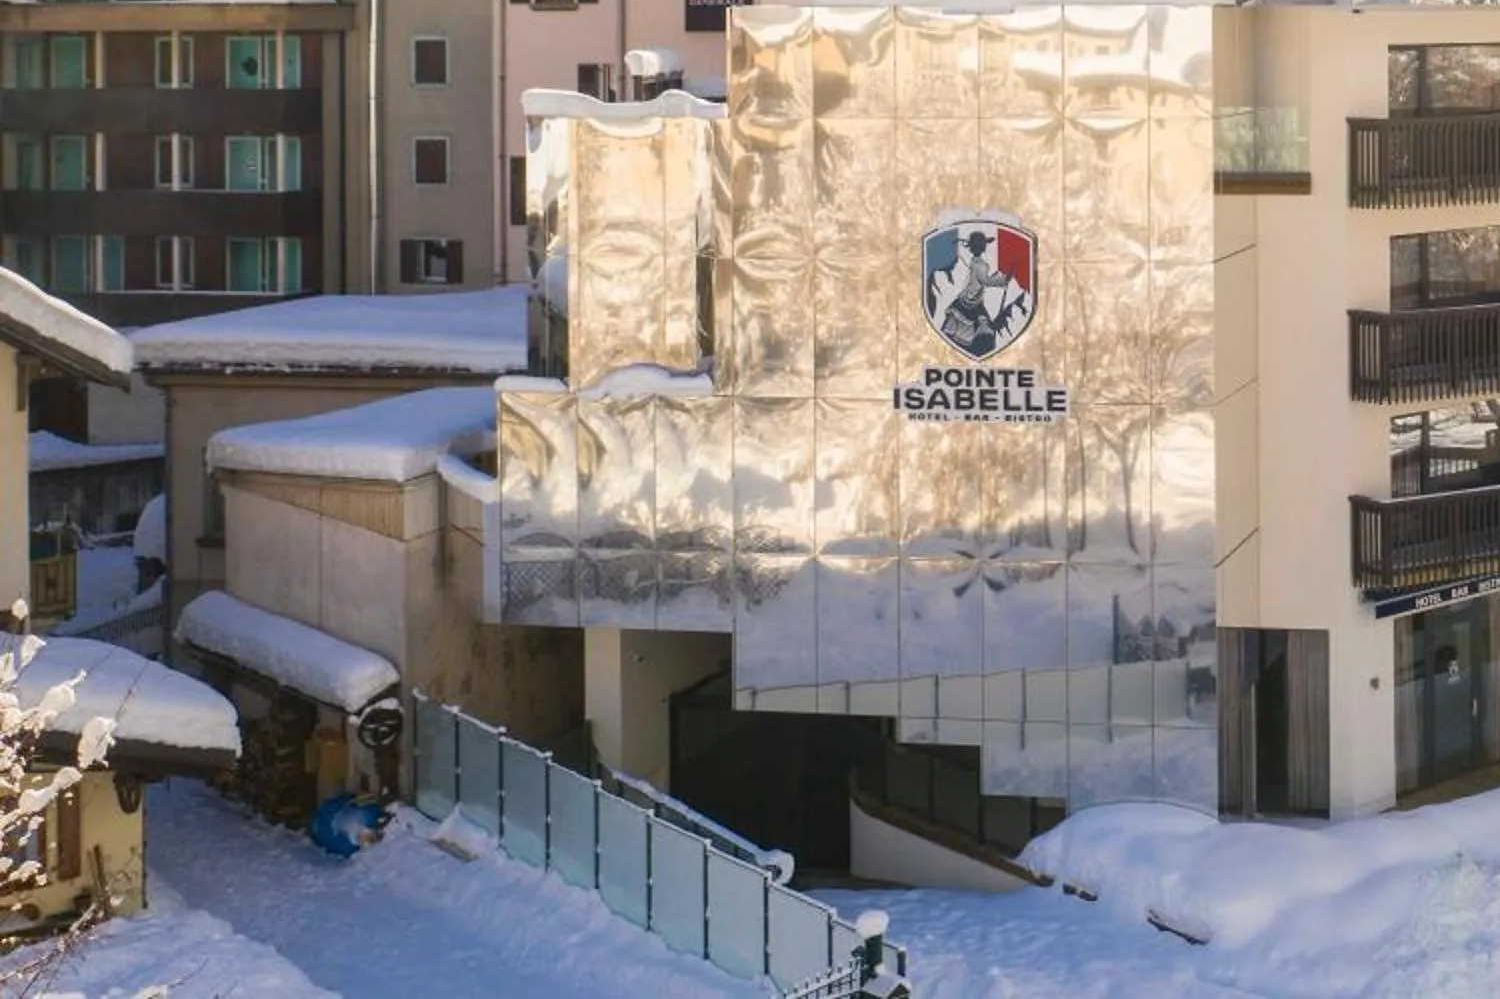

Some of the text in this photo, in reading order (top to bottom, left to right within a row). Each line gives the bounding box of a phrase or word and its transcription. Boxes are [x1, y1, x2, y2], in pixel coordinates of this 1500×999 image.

[925, 368, 1034, 388] POINTE
[893, 387, 1067, 412] ISABELLE
[908, 412, 949, 422] HOTEL
[964, 413, 989, 422] BAR
[1004, 413, 1053, 423] BISTRO
[1415, 592, 1441, 609] HOTEL
[1451, 584, 1470, 599] BAR
